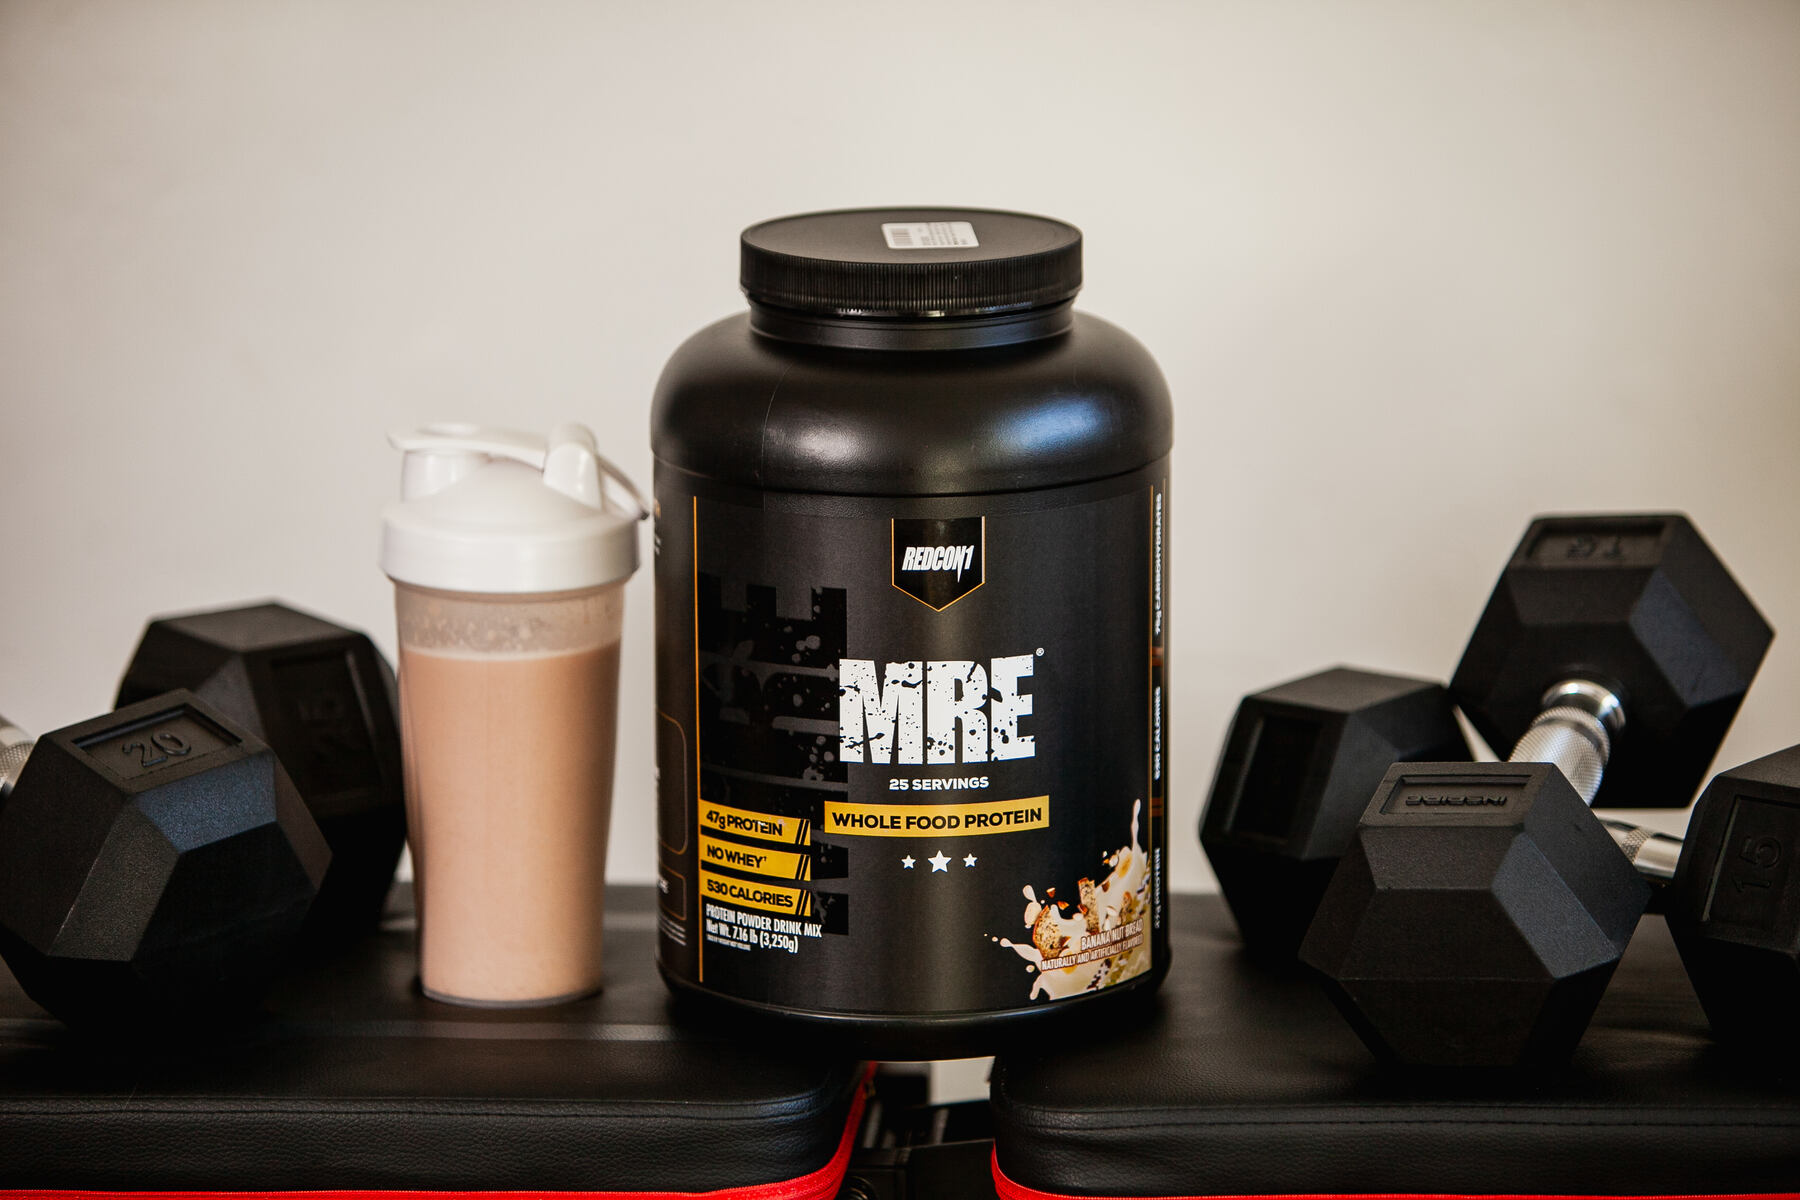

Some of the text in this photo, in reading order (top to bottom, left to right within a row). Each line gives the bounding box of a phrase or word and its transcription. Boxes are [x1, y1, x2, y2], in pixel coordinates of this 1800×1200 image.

[902, 545, 975, 583] REDCON1
[122, 733, 192, 768] 20
[889, 776, 990, 791] 25 SERVINGS
[706, 810, 783, 836] 47g PROTEIN
[832, 807, 1042, 830] WHOLE FOOD PROTEIN
[707, 844, 724, 860] NO
[707, 879, 793, 908] 530 CALORIES
[706, 903, 822, 938] PROTEIN POWDER DRINK MIX
[1081, 918, 1143, 951] BANANA NUT BREAD
[706, 918, 718, 934] Net
[732, 925, 748, 942] 7.16
[749, 928, 758, 944] lb
[760, 931, 799, 954] (3,250g)
[1041, 955, 1077, 971] NATURALLY
[1077, 952, 1090, 964] AND
[1090, 943, 1122, 960] ARTIFICIALLY
